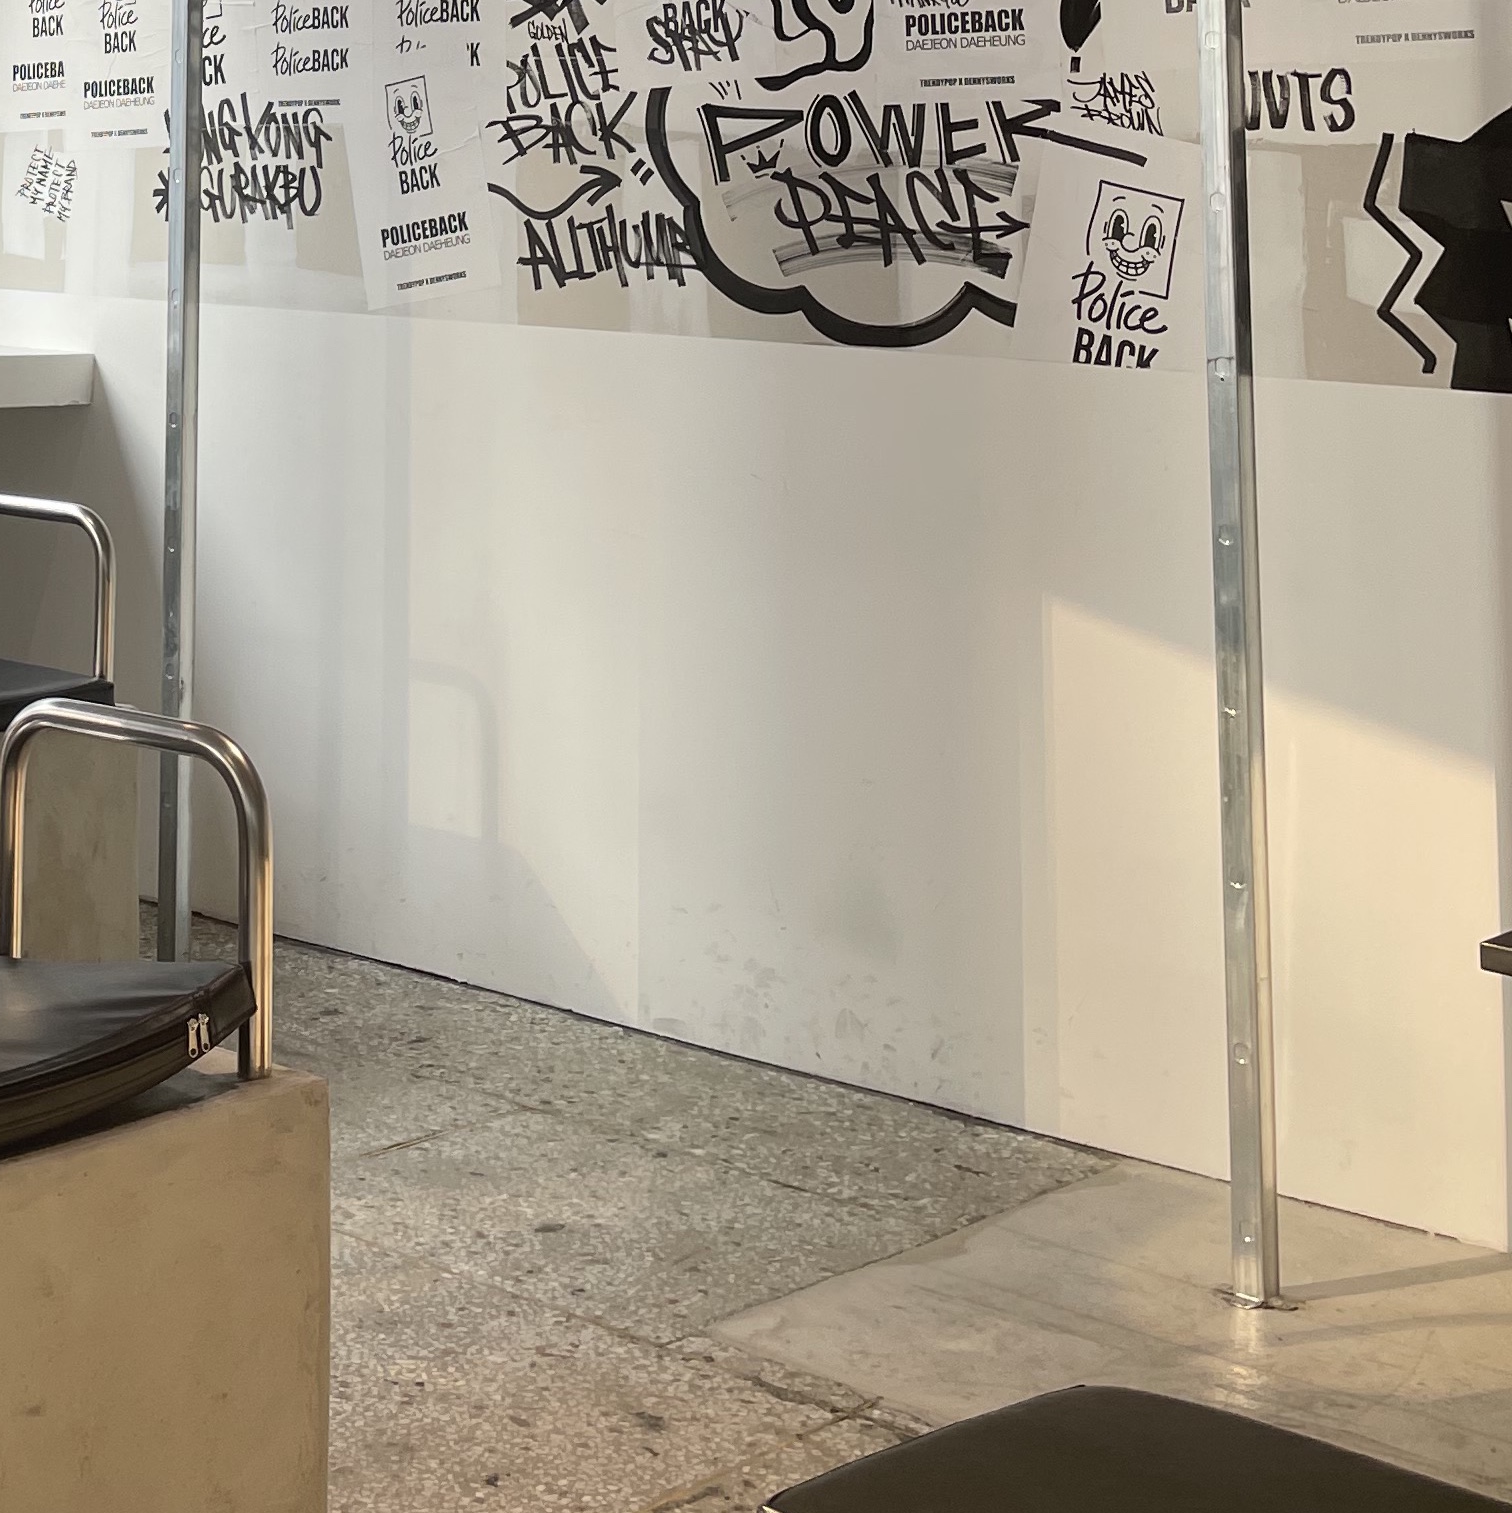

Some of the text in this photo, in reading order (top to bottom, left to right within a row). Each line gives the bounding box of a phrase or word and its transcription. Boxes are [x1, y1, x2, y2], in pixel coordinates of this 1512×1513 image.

[32, 14, 64, 38] BACK
[528, 17, 569, 45] GOLDEN
[905, 8, 1024, 37] POLICEBACK
[104, 30, 137, 54] BACK
[905, 34, 1026, 51] DAEJEON DAEHEUNG
[84, 76, 155, 98] POLICEBACK
[1067, 71, 1155, 113] JAMES
[388, 132, 438, 168] Police
[29, 145, 55, 205] MY NAME
[399, 163, 440, 195] BACK
[381, 211, 469, 248] POLICEBACK
[383, 244, 422, 261] DAEJEON
[1071, 261, 1168, 334] Police
